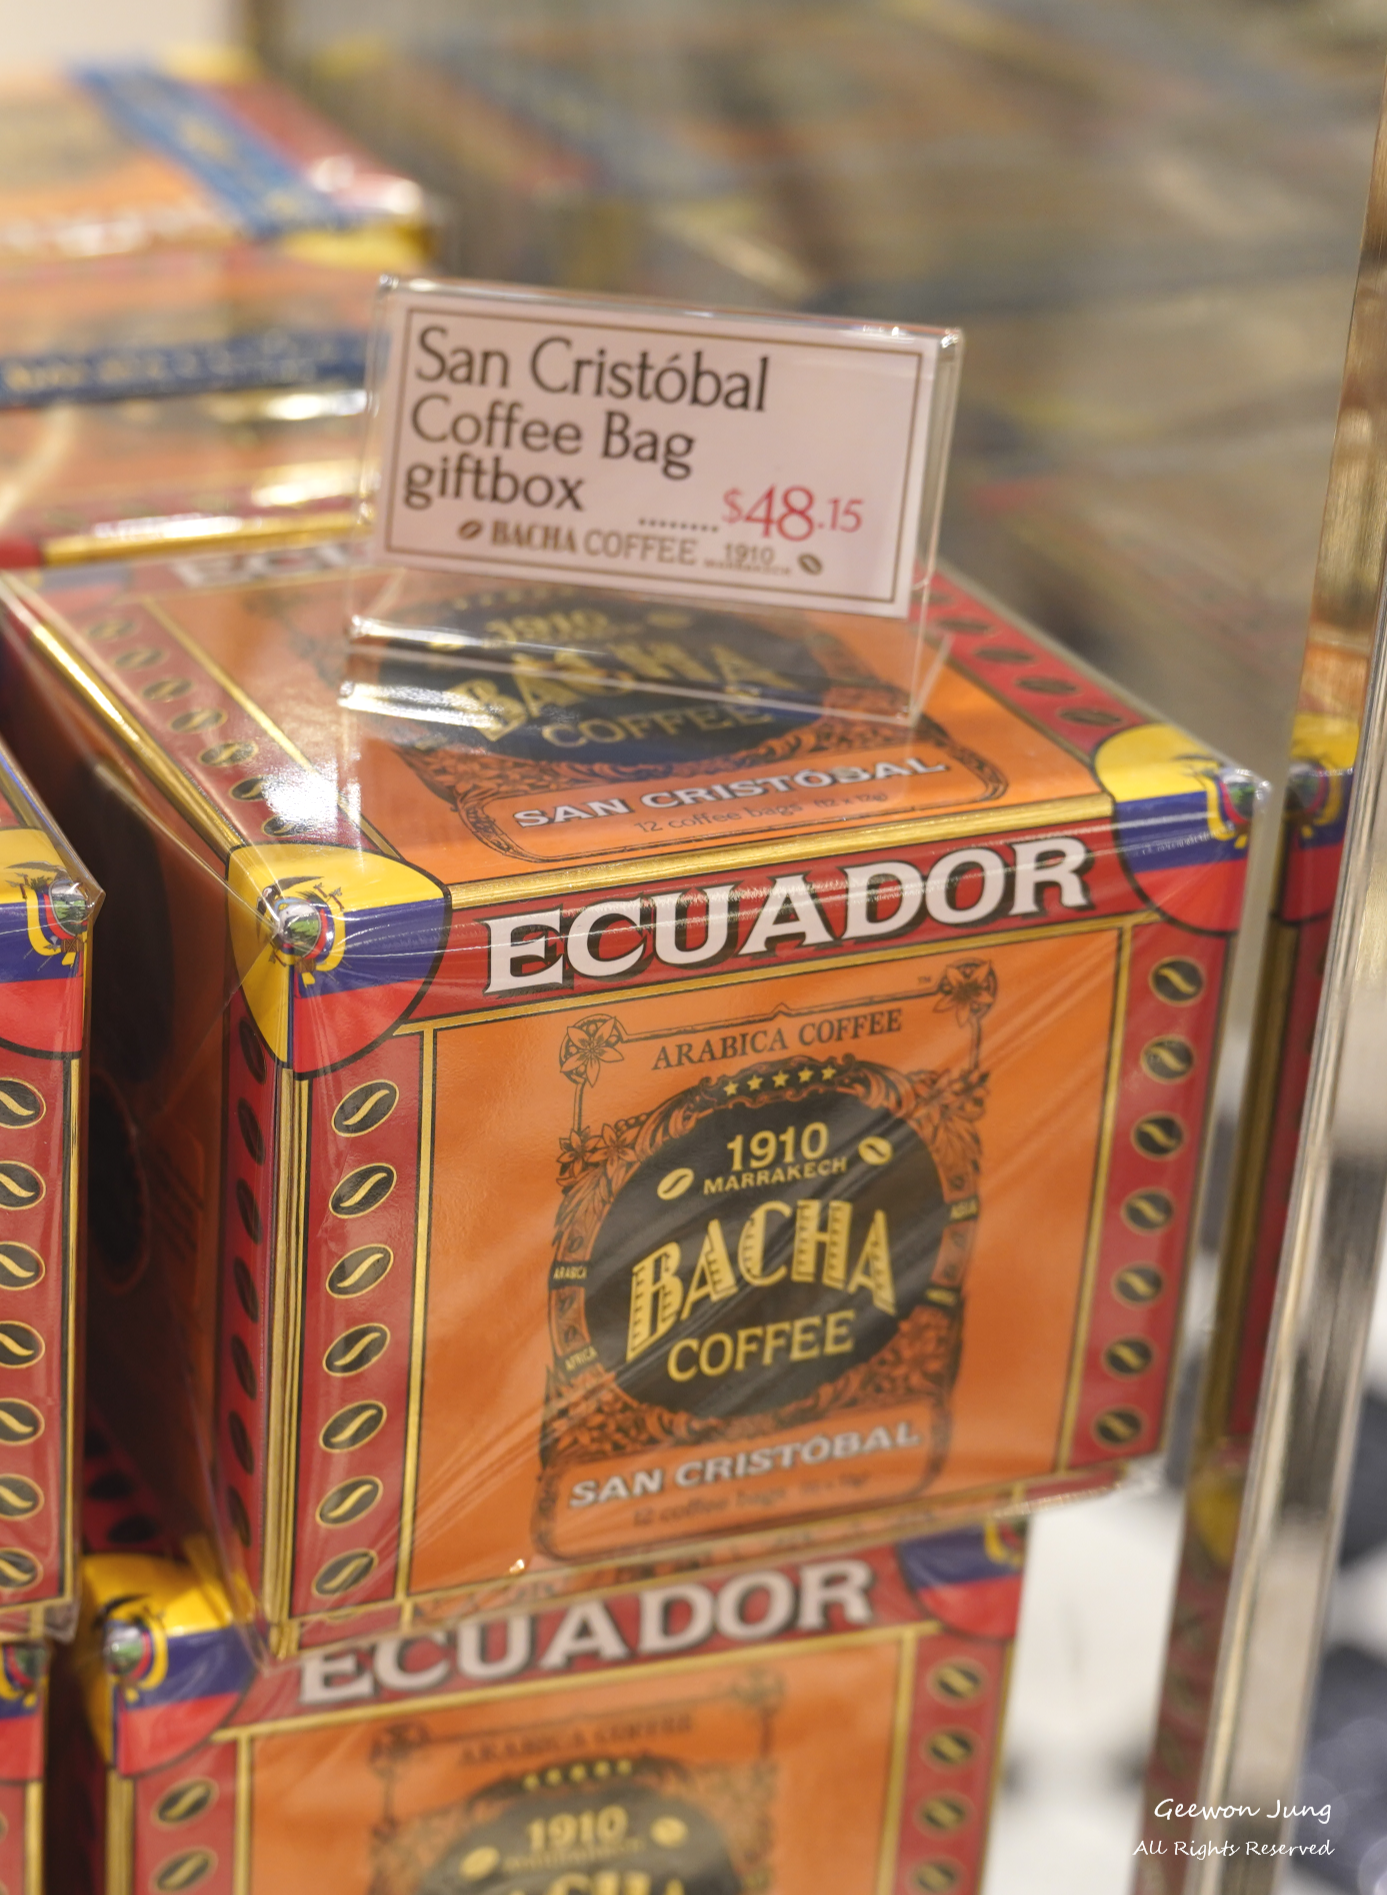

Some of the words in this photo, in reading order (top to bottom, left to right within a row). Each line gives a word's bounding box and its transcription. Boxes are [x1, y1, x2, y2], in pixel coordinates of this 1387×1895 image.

[415, 324, 510, 390] San
[529, 334, 770, 413] Cristóbal
[410, 393, 584, 456] Coffee
[601, 410, 696, 481] Bag
[403, 452, 585, 511] giftbox
[491, 518, 577, 551] BACHA
[583, 528, 698, 566] COFFEE
[723, 543, 776, 566] 1910
[540, 702, 775, 748] COFFEE
[513, 796, 634, 829] SAN
[639, 756, 948, 810] CRISTÓBAL
[633, 819, 664, 834] 12
[668, 809, 743, 829] coffee
[745, 801, 805, 819] bags
[483, 835, 1096, 996] ECUADOR
[651, 1026, 791, 1072] ARABICA
[797, 1007, 904, 1047] COFFEE
[702, 1155, 850, 1196] MARRAKECH
[725, 1121, 829, 1174] 1910
[625, 1198, 899, 1364] BACHA
[666, 1310, 857, 1383] COFFEE
[568, 1467, 666, 1509] SAN
[674, 1420, 923, 1491] CRISTÓBAL
[298, 1557, 877, 1705] ECUADOR
[526, 1803, 630, 1853] 1910
